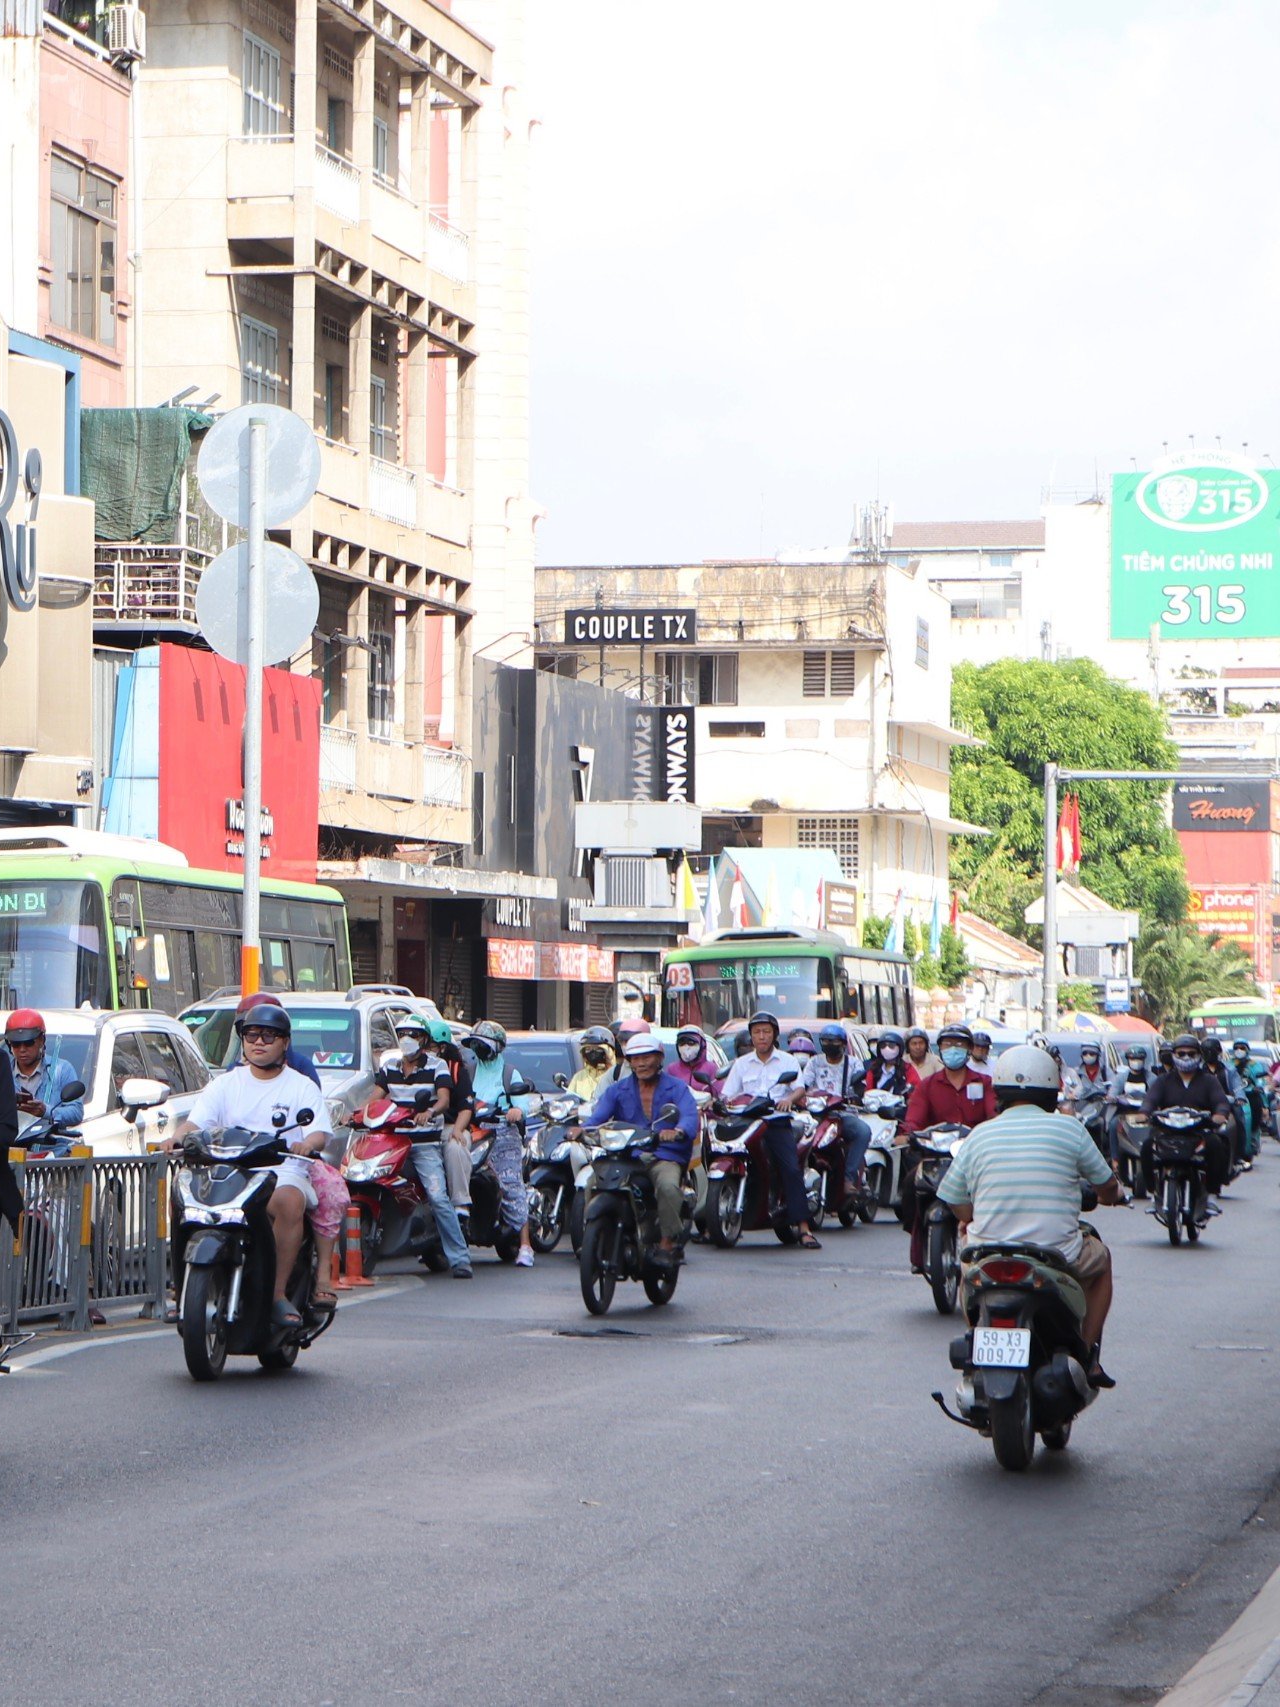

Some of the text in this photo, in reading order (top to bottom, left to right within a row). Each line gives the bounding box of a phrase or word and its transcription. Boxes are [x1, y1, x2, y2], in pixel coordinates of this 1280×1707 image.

[1197, 488, 1253, 515] 315
[1122, 548, 1273, 571] TIÊM CHỦNG NHI
[1161, 584, 1246, 625] 315
[574, 615, 688, 639] COUPLE TX
[1204, 889, 1254, 911] phone
[670, 967, 690, 987] 03
[314, 1051, 352, 1064] VTV
[983, 1331, 1022, 1347] 59-X3
[977, 1347, 1026, 1364] 009.77
